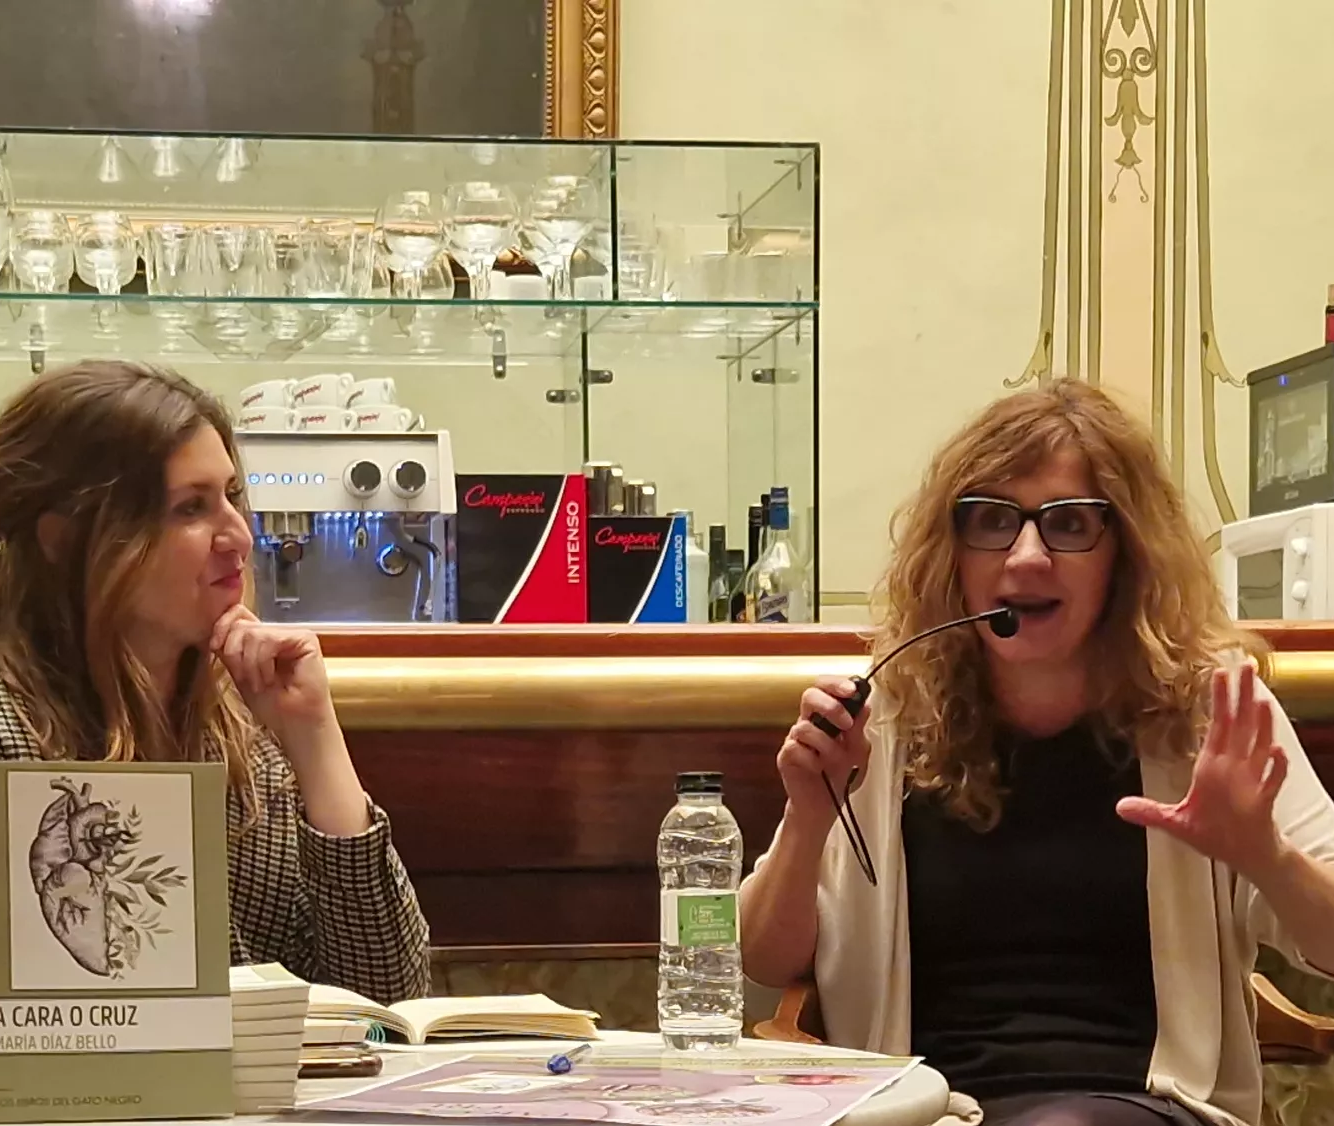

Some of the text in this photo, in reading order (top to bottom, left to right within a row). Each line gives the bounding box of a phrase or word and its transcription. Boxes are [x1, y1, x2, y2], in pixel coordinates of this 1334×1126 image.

[567, 501, 580, 584] INTENSO
[12, 1005, 64, 1027] CARA
[70, 1005, 83, 1027] O
[89, 1005, 139, 1026] CRUZ
[41, 1031, 72, 1050] DÍAZ
[75, 1034, 117, 1050] BELLO
[52, 1096, 71, 1107] DEL
[72, 1095, 102, 1106] GATO
[103, 1094, 142, 1105] NEGRO
